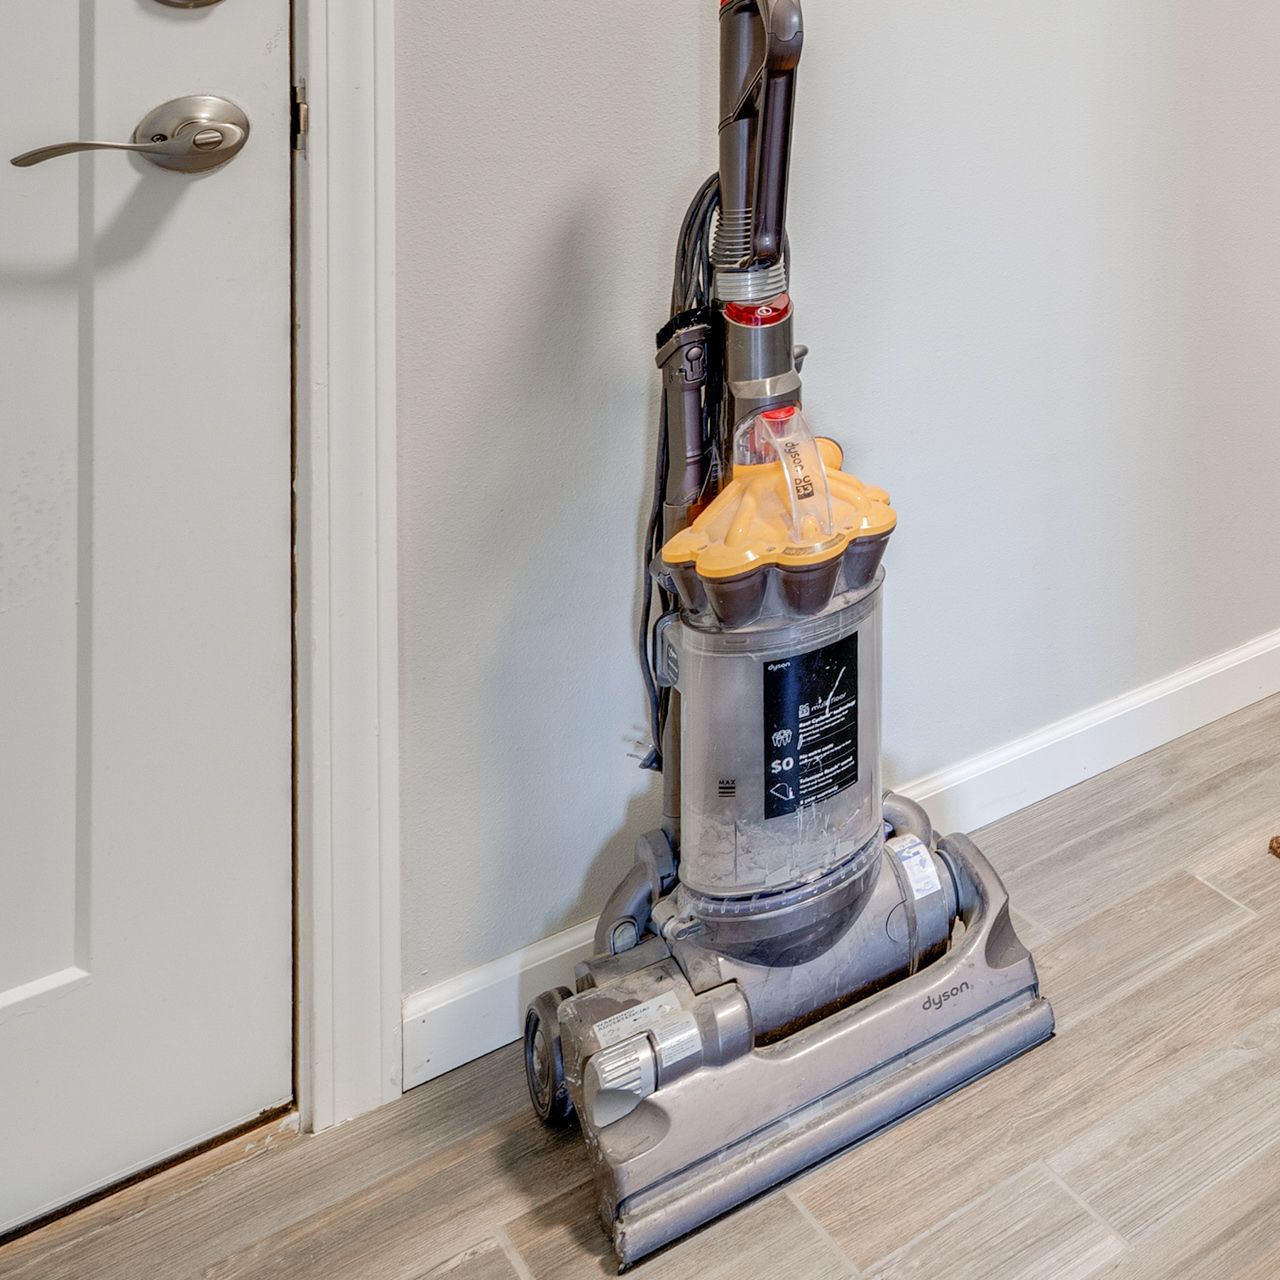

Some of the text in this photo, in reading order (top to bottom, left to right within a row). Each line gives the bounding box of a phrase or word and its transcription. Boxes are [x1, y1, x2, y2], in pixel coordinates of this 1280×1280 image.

[784, 441, 804, 472] dyson
[767, 661, 791, 672] dyson
[771, 756, 794, 774] $0
[922, 981, 970, 1010] dyson
